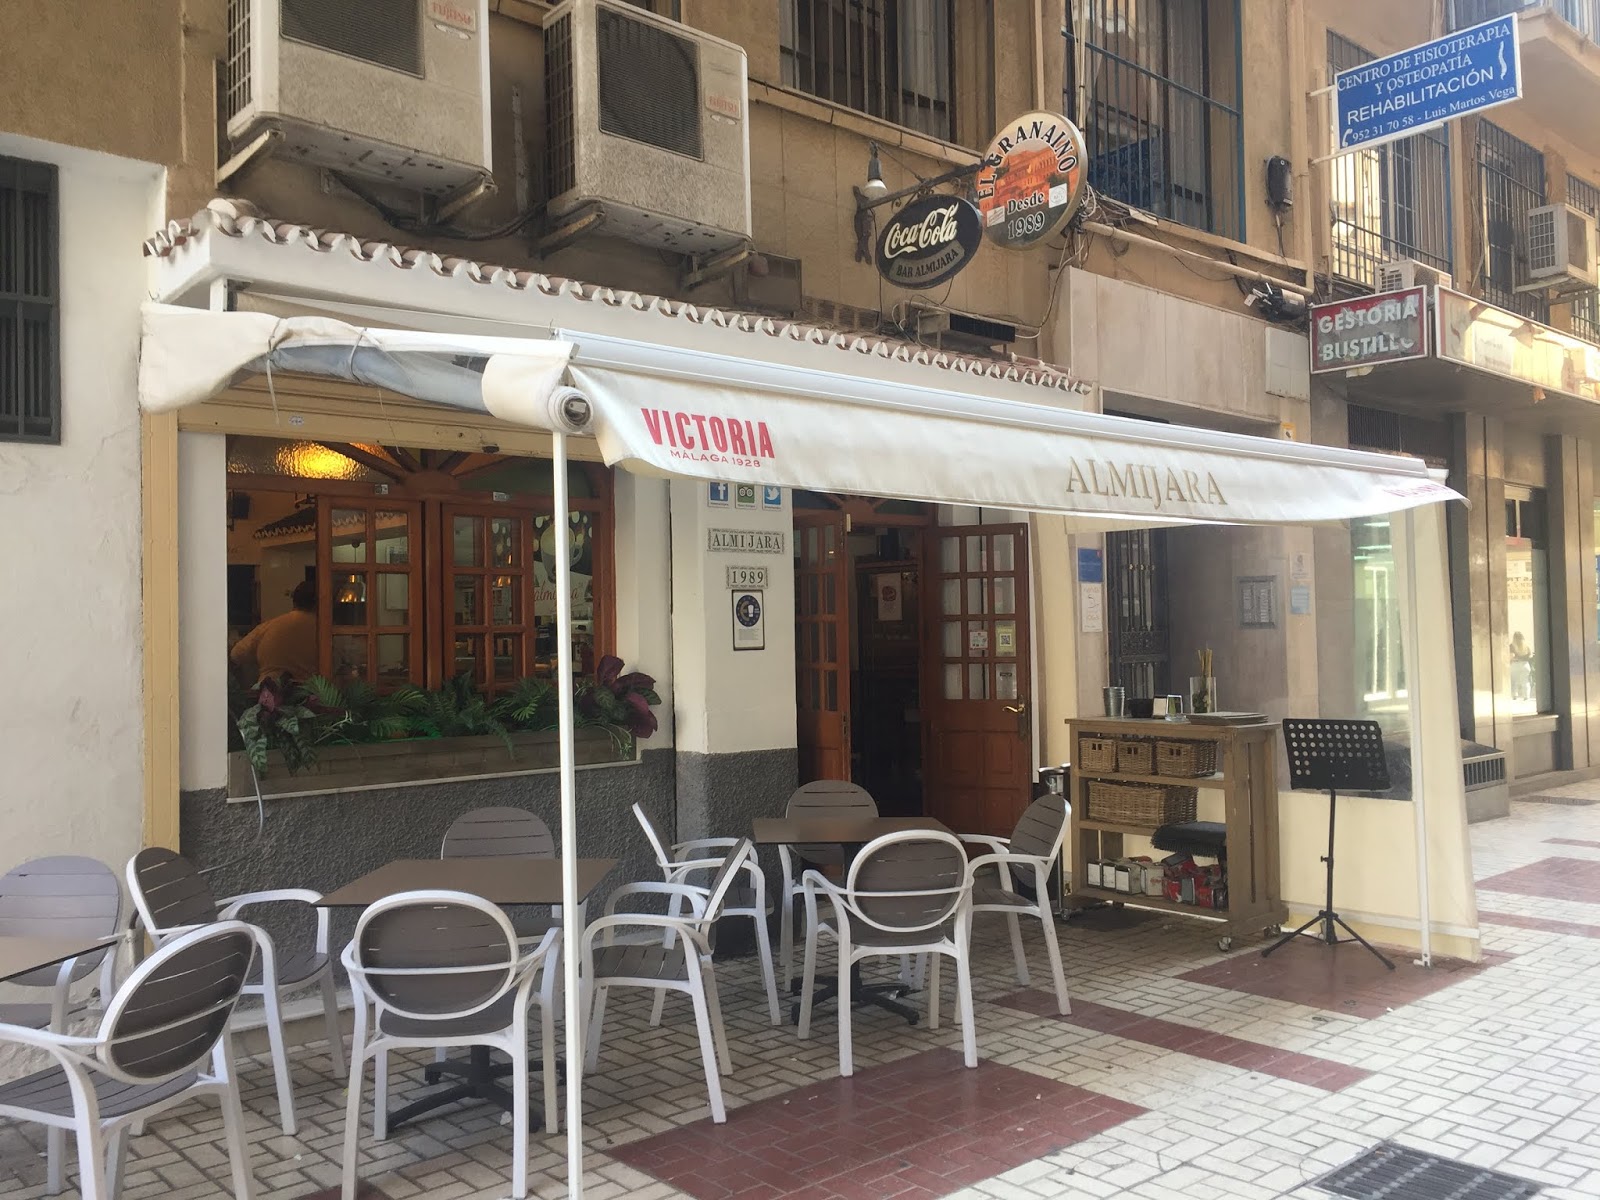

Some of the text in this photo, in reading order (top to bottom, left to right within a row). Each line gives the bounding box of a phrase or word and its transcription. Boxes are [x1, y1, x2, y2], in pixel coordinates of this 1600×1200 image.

[1337, 23, 1511, 92] CENTRO DE FISIOTERAPIA
[1375, 53, 1473, 96] Y OSTEOPATÍA
[1347, 66, 1494, 125] REHABILITACIÓN
[1352, 129, 1370, 142] 952
[1372, 125, 1384, 138] 31
[1387, 120, 1399, 132] 70
[1402, 116, 1415, 127] 58
[1424, 106, 1447, 122] Luis
[1449, 94, 1486, 114] Martos
[1488, 86, 1515, 102] Vega
[978, 121, 1077, 200] EL GRANAINO
[1007, 190, 1045, 216] Desde
[1007, 211, 1046, 241] 1989
[896, 248, 959, 278] BAR ALMIJARA
[1319, 303, 1417, 333] GESTORIA
[640, 407, 775, 459] VICTORIA
[732, 457, 761, 468] 1928
[1066, 456, 1228, 510] ALMIJARA
[712, 533, 781, 550] ALMIJARA
[732, 570, 764, 584] 1989
